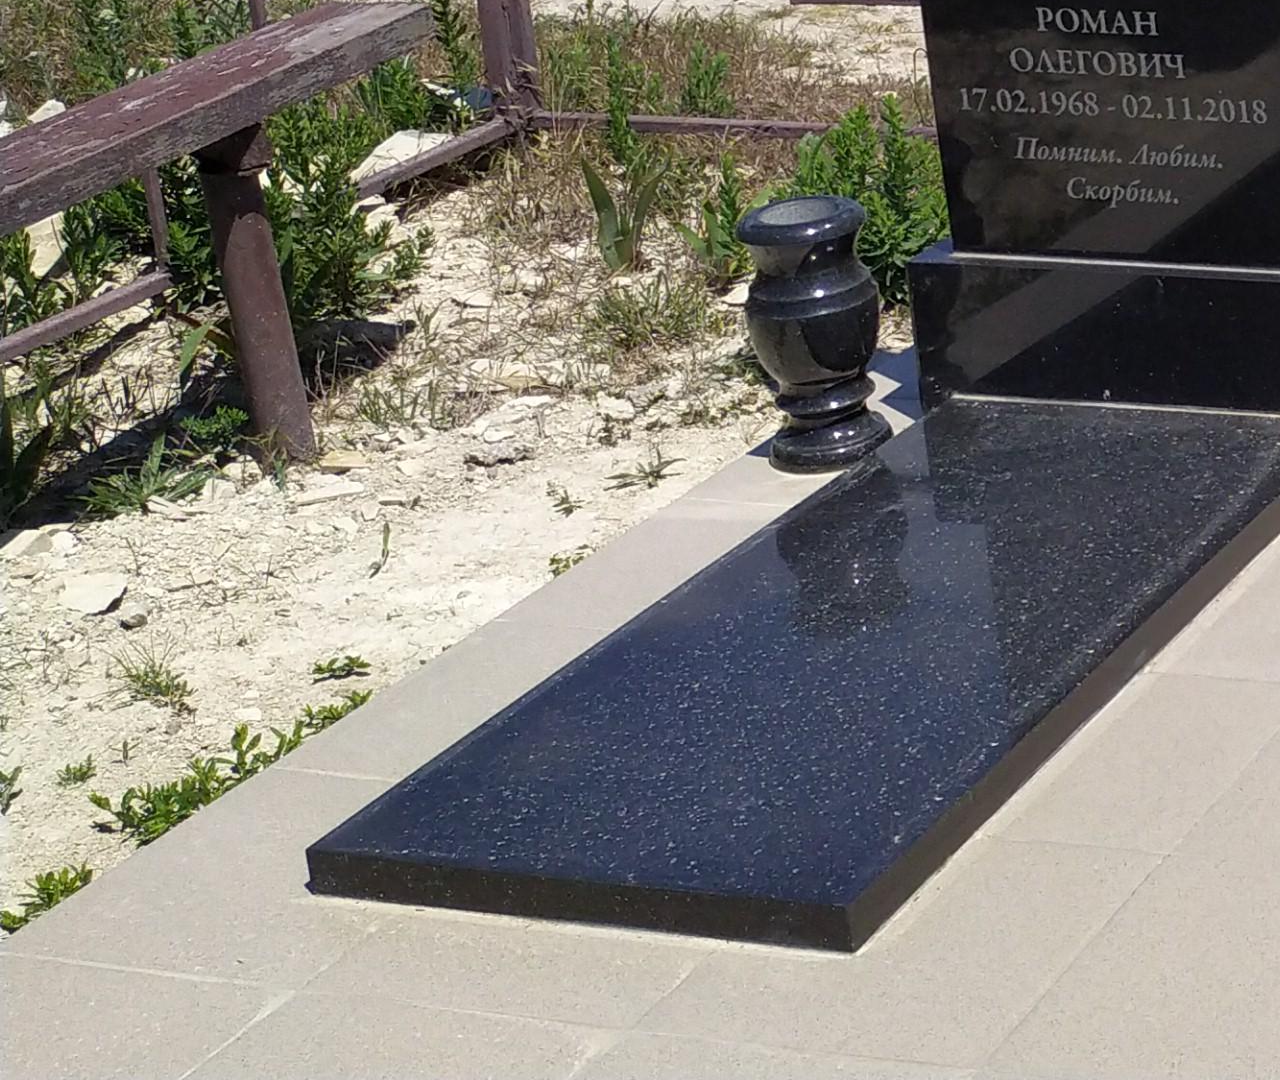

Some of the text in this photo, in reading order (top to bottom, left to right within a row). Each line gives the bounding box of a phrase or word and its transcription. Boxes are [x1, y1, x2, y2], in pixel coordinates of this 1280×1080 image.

[1035, 7, 1159, 37] РОМАН
[1009, 47, 1186, 80] ОЛЕГОВИЧ
[959, 87, 1100, 117] 17.02.1968
[1122, 94, 1268, 124] 02.11.2018
[1013, 136, 1224, 169] Помним. Любим.
[1066, 176, 1180, 208] Скорбим.
